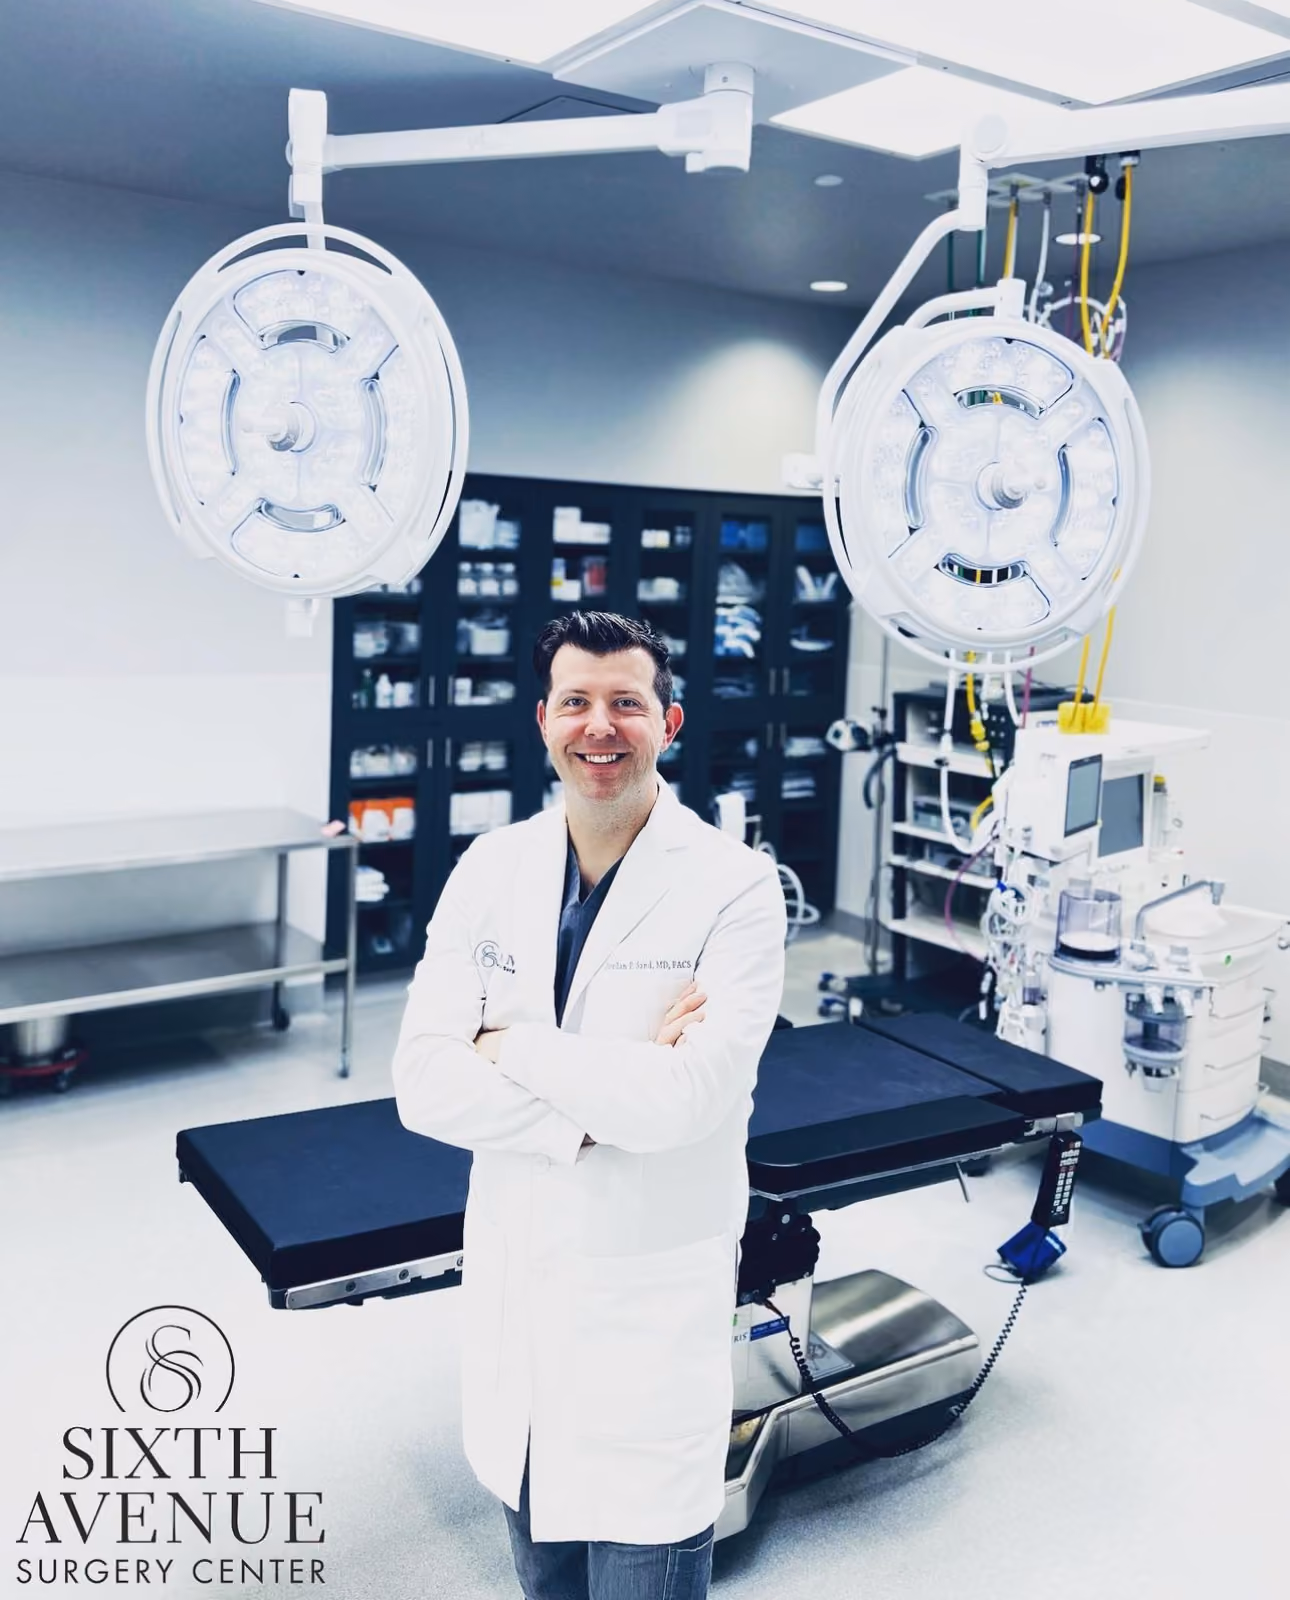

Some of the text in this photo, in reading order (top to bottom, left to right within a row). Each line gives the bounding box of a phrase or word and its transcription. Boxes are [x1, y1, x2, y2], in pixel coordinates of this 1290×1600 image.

[656, 960, 671, 971] MD,
[672, 960, 692, 969] FACS
[732, 1331, 748, 1343] RIS
